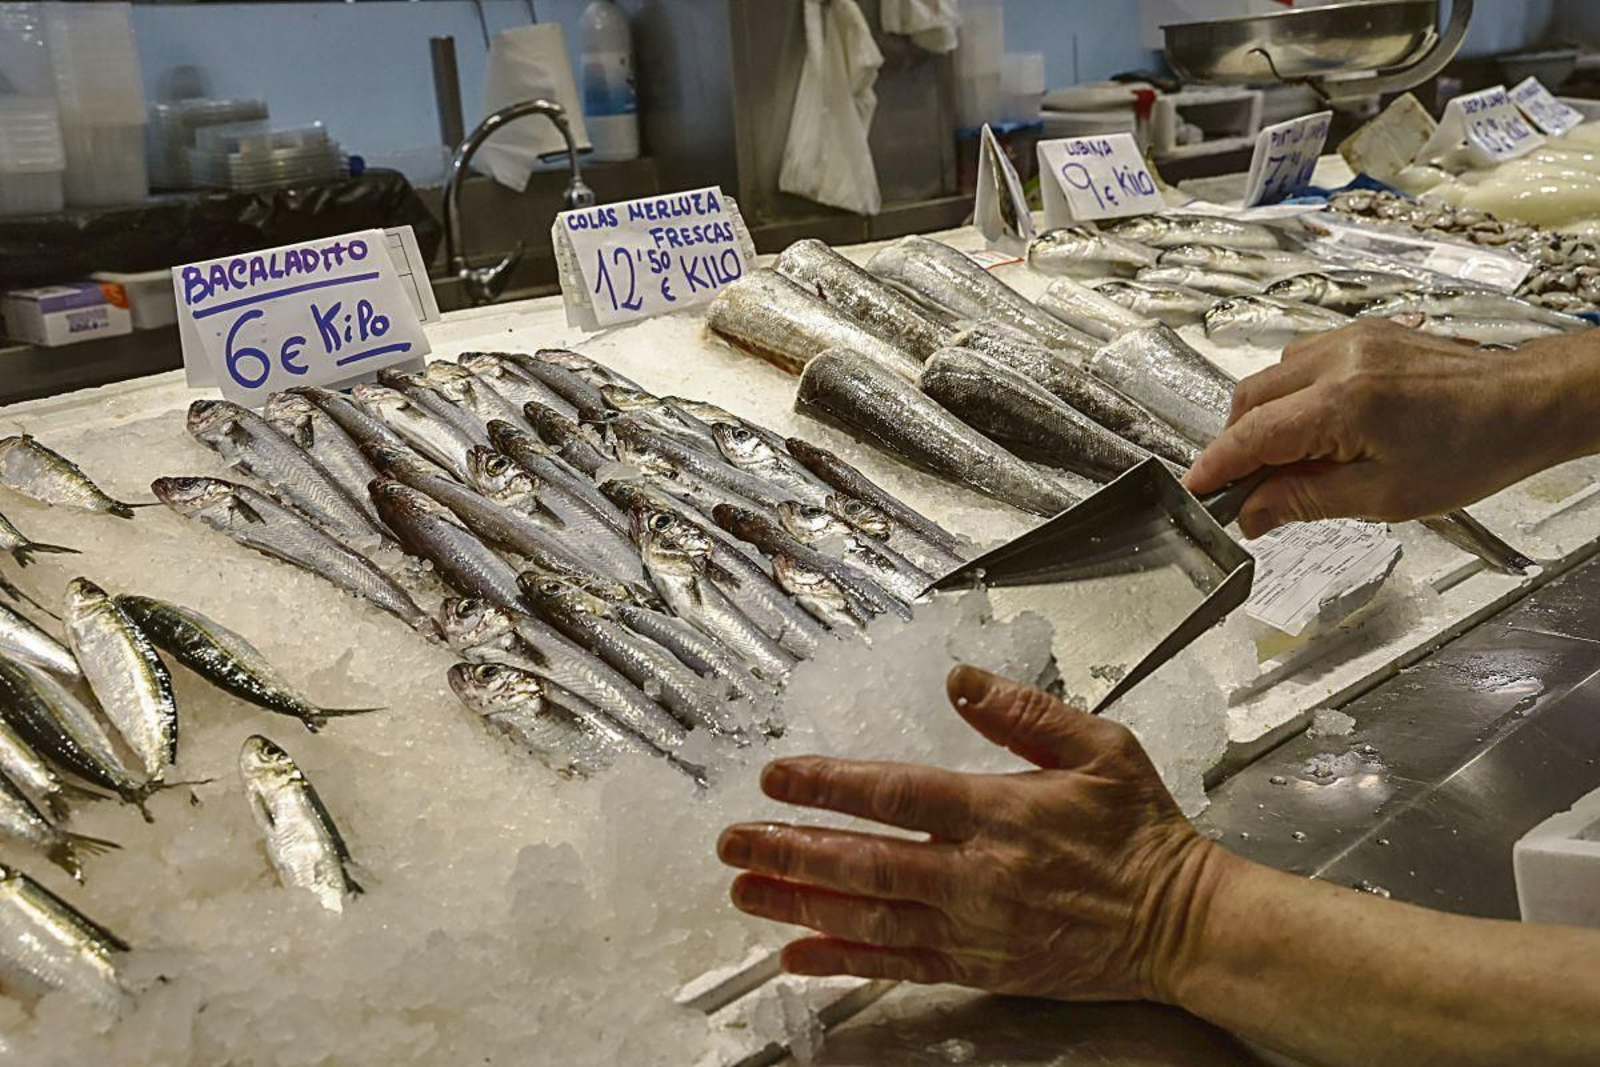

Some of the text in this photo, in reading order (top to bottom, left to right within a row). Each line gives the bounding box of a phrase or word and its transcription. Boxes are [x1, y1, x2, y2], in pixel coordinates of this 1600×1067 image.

[1064, 139, 1113, 158] LUBINA
[567, 191, 721, 231] COLAS MERLUZA
[649, 222, 734, 249] FRESCAS
[680, 248, 742, 293] KILO
